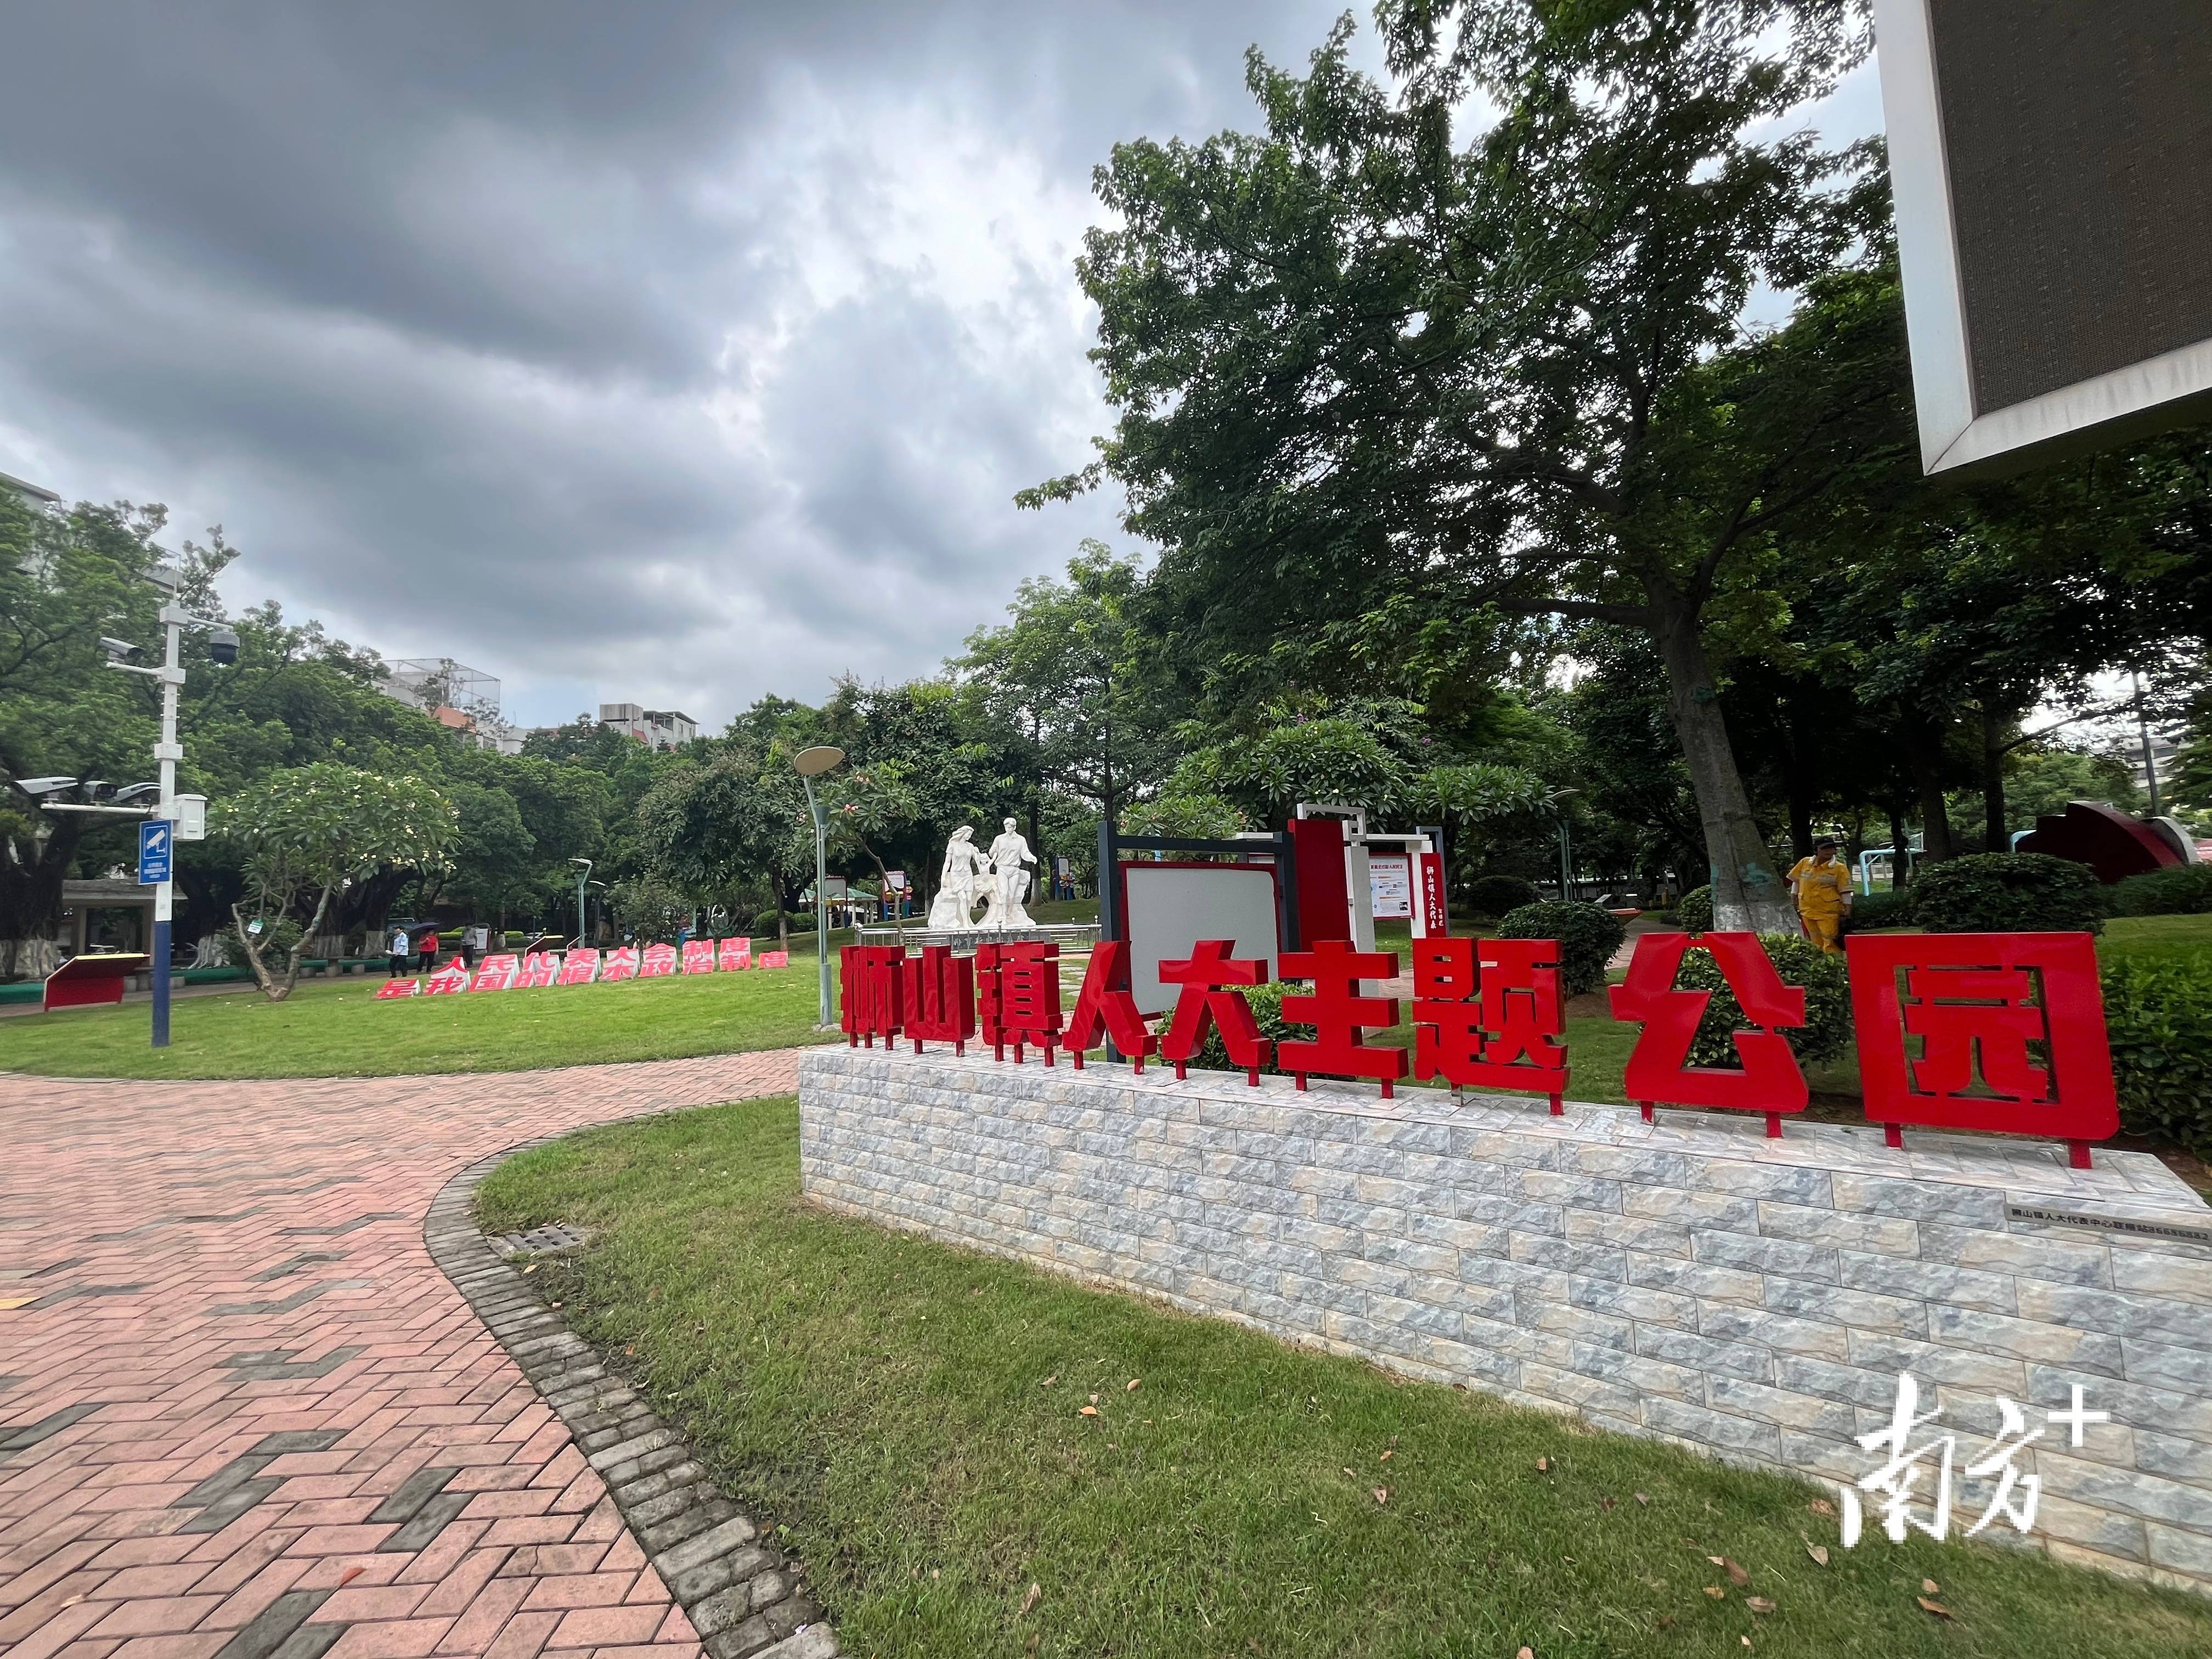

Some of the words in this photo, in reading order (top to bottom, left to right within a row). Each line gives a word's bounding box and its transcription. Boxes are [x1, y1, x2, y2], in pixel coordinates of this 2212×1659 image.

[373, 950, 789, 1000] 是我国的根本政治制度
[431, 937, 751, 975] 人民代表大会制度
[840, 931, 2120, 1141] 狮山镇人大主题公园
